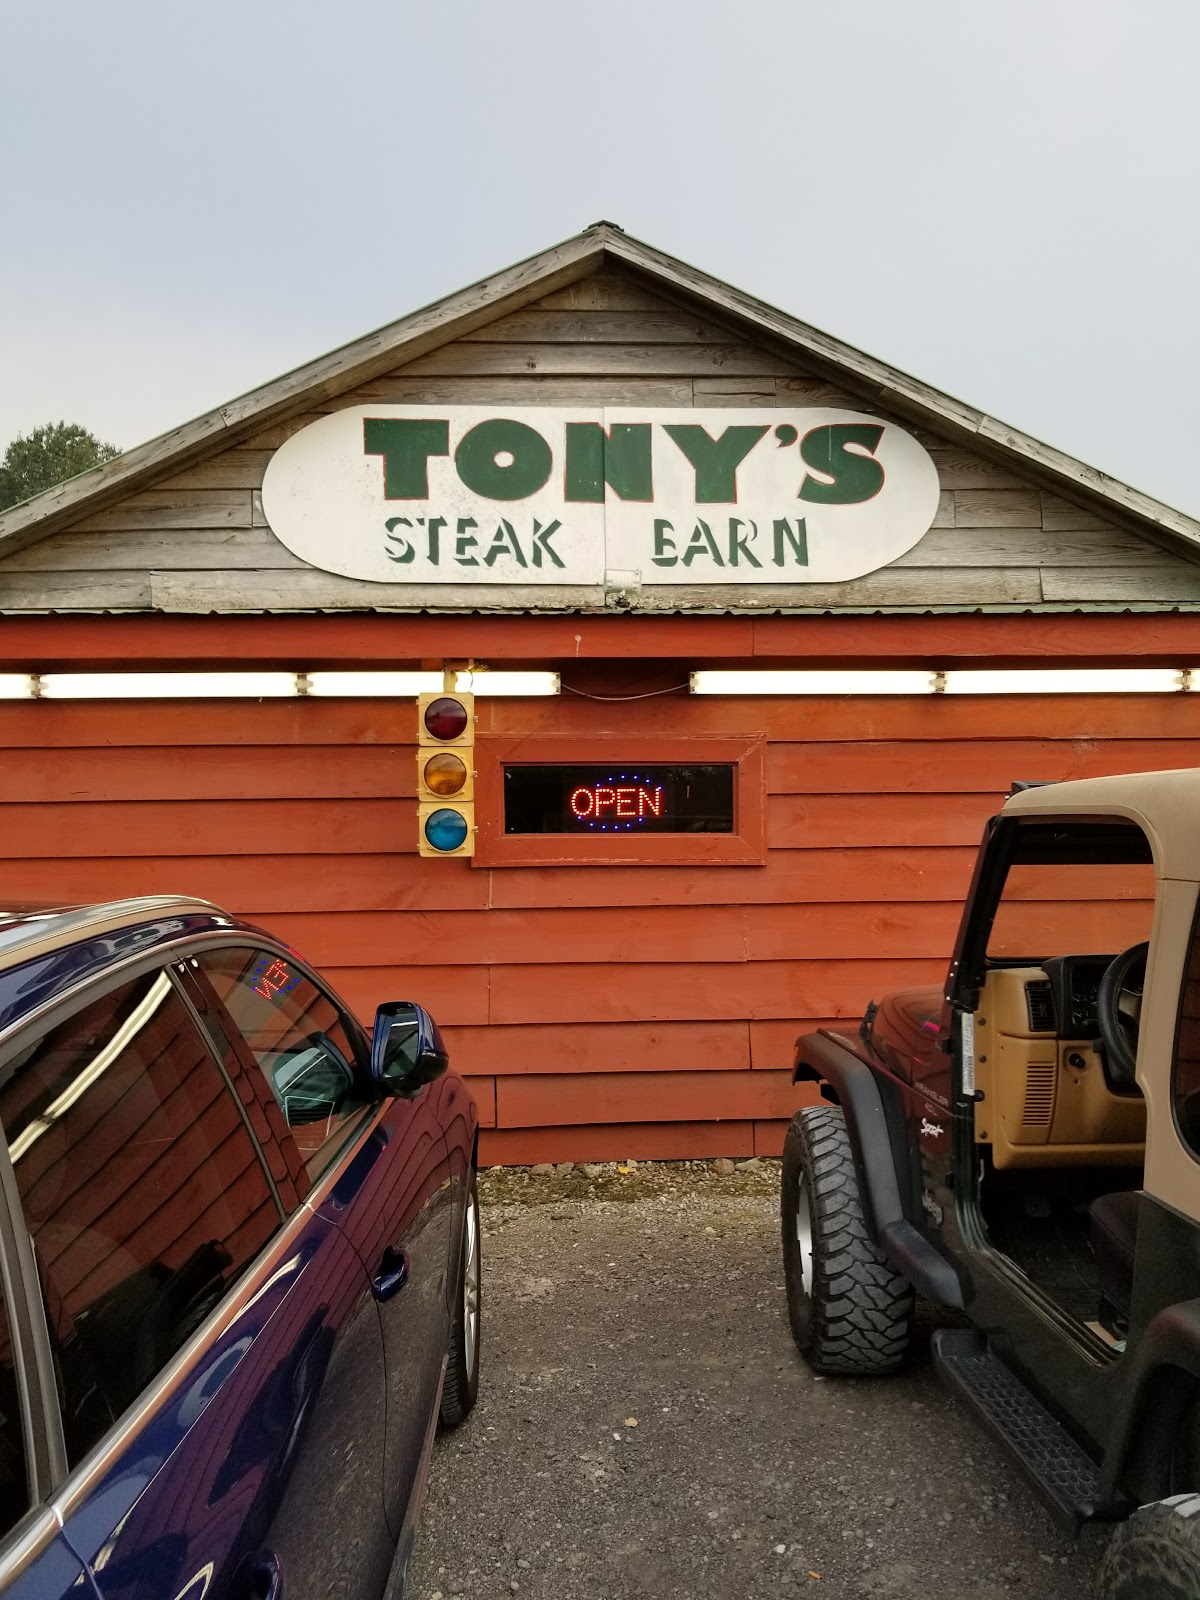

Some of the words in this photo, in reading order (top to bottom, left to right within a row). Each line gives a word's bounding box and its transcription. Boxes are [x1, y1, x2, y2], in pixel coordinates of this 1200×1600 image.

[363, 417, 886, 505] TONY'S
[384, 515, 567, 568] STEAK
[651, 516, 809, 568] BARN
[571, 787, 660, 816] OPEN
